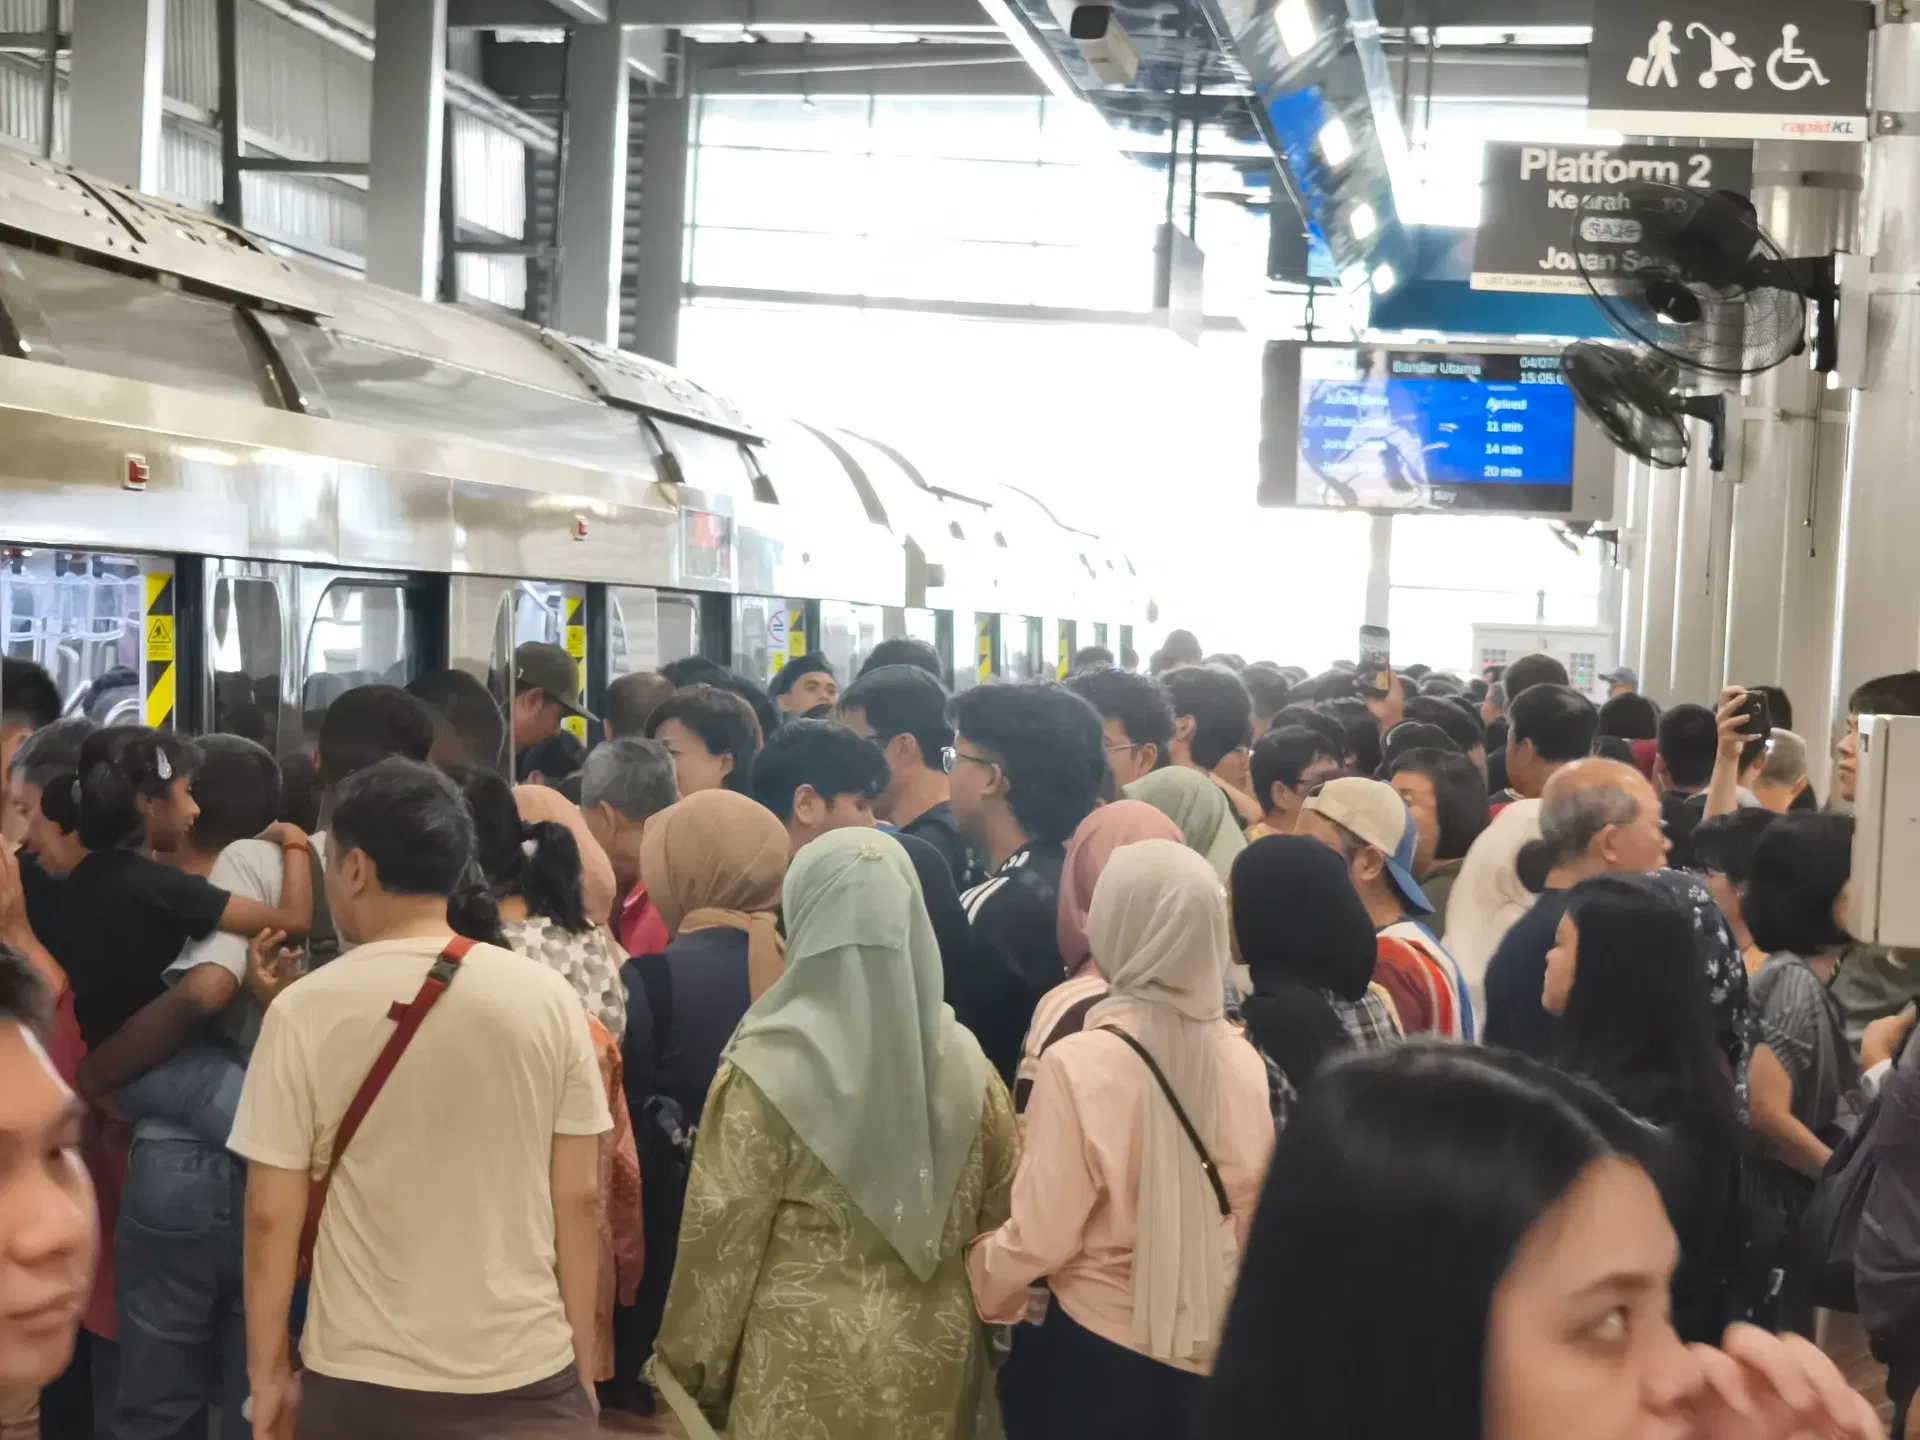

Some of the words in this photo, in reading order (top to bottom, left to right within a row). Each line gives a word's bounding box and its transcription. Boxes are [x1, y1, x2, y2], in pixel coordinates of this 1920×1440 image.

[1520, 147, 1679, 185] Platform
[1687, 154, 1712, 188] 2
[1547, 189, 1578, 209] Ke
[1393, 361, 1437, 374] Bandar
[1440, 363, 1481, 375] Utama
[1486, 398, 1527, 411] Arrived
[1486, 421, 1499, 432] 11
[1502, 423, 1523, 433] min
[1486, 444, 1499, 455] 14
[1502, 445, 1523, 455] min
[1484, 466, 1499, 477] 20
[1501, 467, 1522, 478] min
